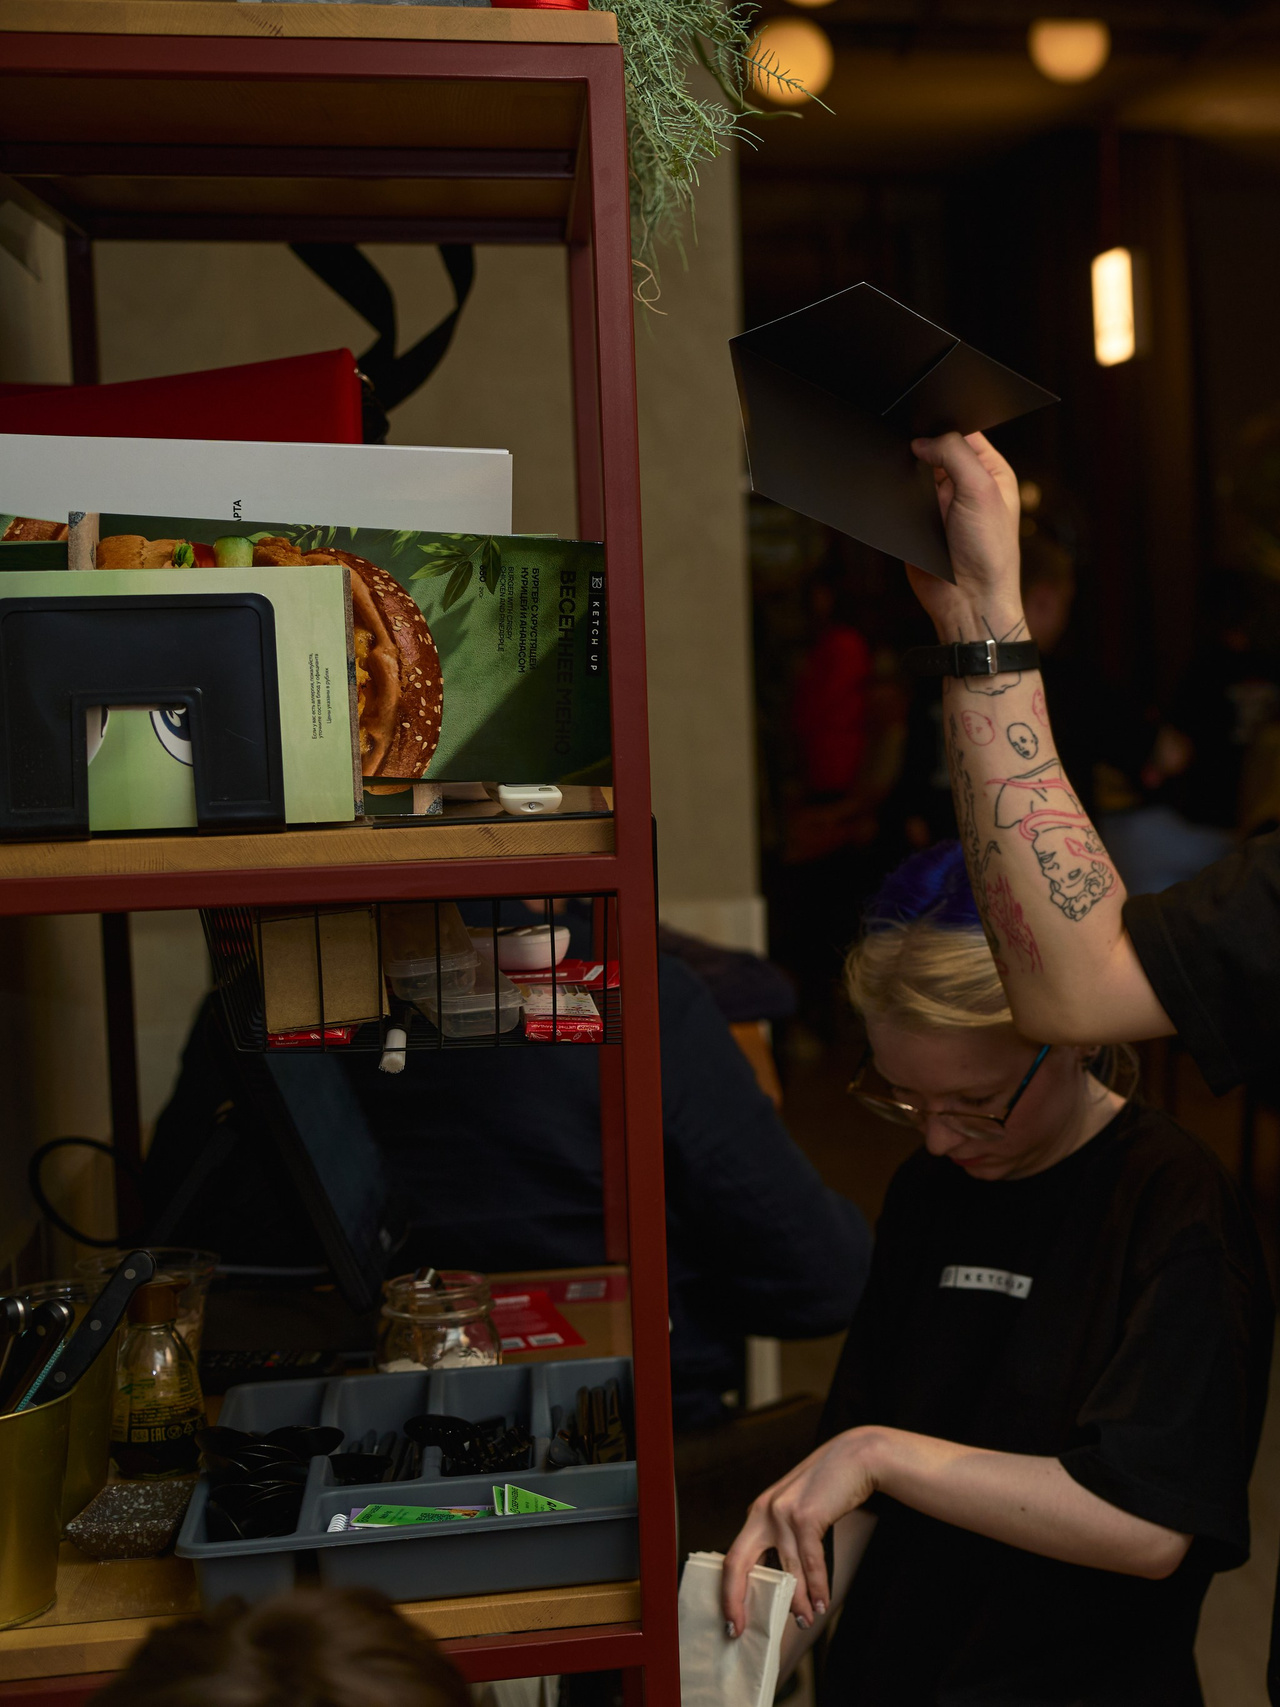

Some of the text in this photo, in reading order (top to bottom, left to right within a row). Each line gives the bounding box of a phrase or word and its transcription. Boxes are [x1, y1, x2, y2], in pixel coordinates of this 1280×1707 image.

[520, 567, 529, 611] КУРИЦЕЙ
[531, 568, 539, 603] БУРГЕР
[529, 614, 538, 670] ХРУСТЯЩЕЙ
[591, 601, 600, 645] KETCH
[518, 620, 527, 673] АНАНАСОМ
[554, 570, 576, 755] ВЕСЕННЕЕ МЕНЮ
[590, 655, 598, 671] UP
